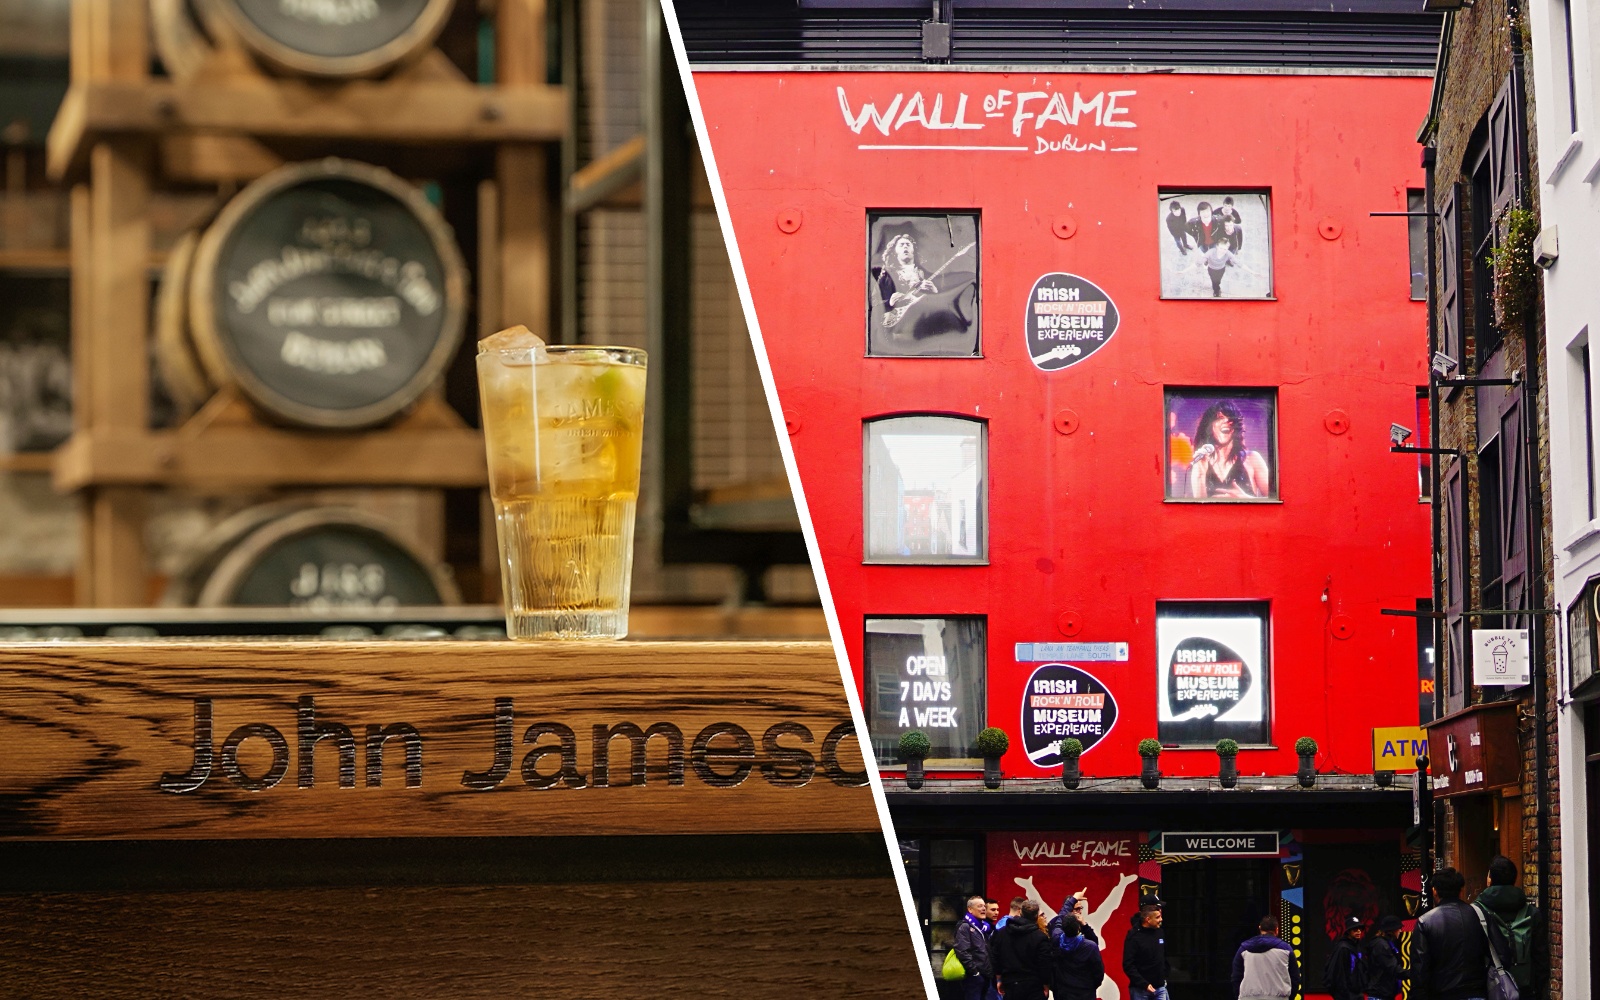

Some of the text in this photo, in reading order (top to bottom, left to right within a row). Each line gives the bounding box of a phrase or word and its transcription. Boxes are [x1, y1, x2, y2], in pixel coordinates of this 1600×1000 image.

[837, 86, 1137, 137] WALL OF FAME
[1038, 288, 1079, 301] IRISH
[1037, 316, 1103, 328] MUSEUM
[1038, 329, 1103, 340] EXPERIENCE
[1484, 636, 1516, 648] BUBBLE TEA
[1177, 650, 1217, 662] IRISH
[906, 656, 945, 676] OPEN
[1033, 680, 1077, 693] IRISH
[1176, 676, 1239, 689] MUSEUM
[900, 682, 951, 701] 7 DAYS
[1177, 689, 1239, 701] EXPERIENCE
[899, 707, 958, 727] A WEEK
[1033, 709, 1101, 723] MUSEUM
[1034, 723, 1101, 735] EXPERIENCE
[160, 695, 422, 793] John
[1382, 740, 1428, 757] ATM
[1013, 839, 1131, 860] WALL OF FAME
[1186, 838, 1256, 849] WELCOME
